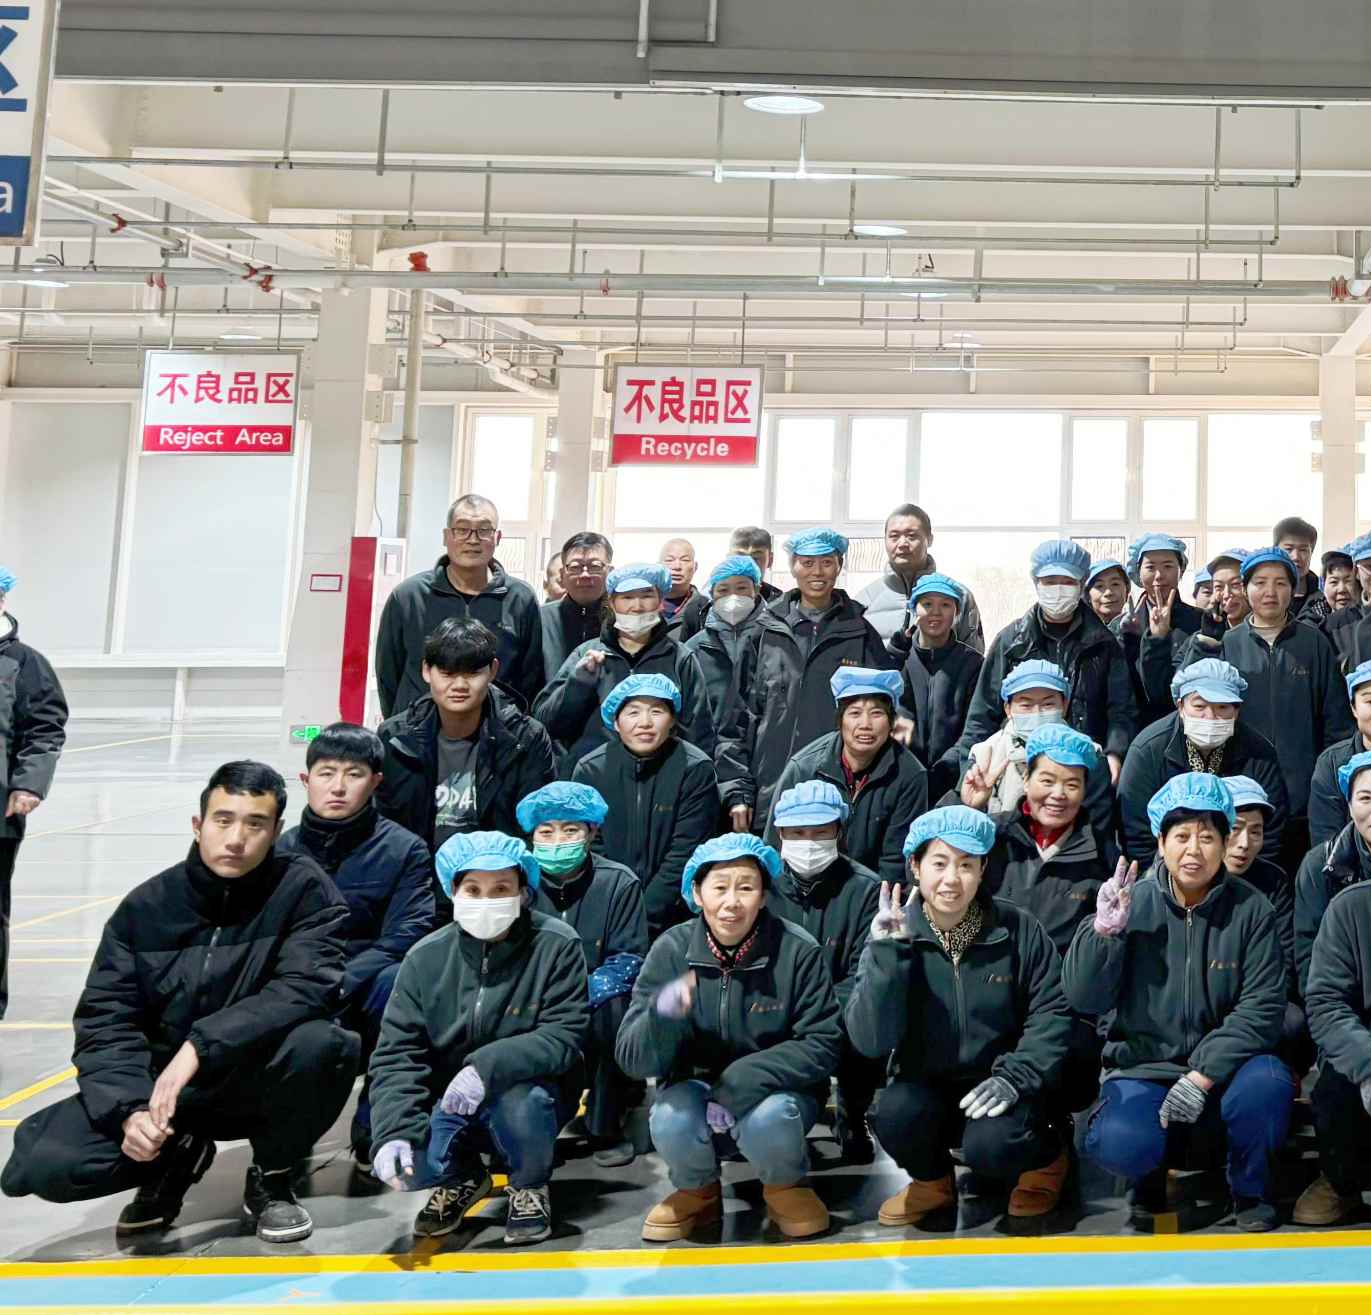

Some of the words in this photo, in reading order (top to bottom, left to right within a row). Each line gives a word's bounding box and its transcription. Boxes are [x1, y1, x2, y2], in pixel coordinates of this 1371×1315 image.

[156, 370, 294, 404] 不良品区
[623, 376, 753, 424] 不良品区
[159, 427, 225, 449] Reject
[235, 428, 284, 446] Area
[640, 437, 730, 460] Recycle
